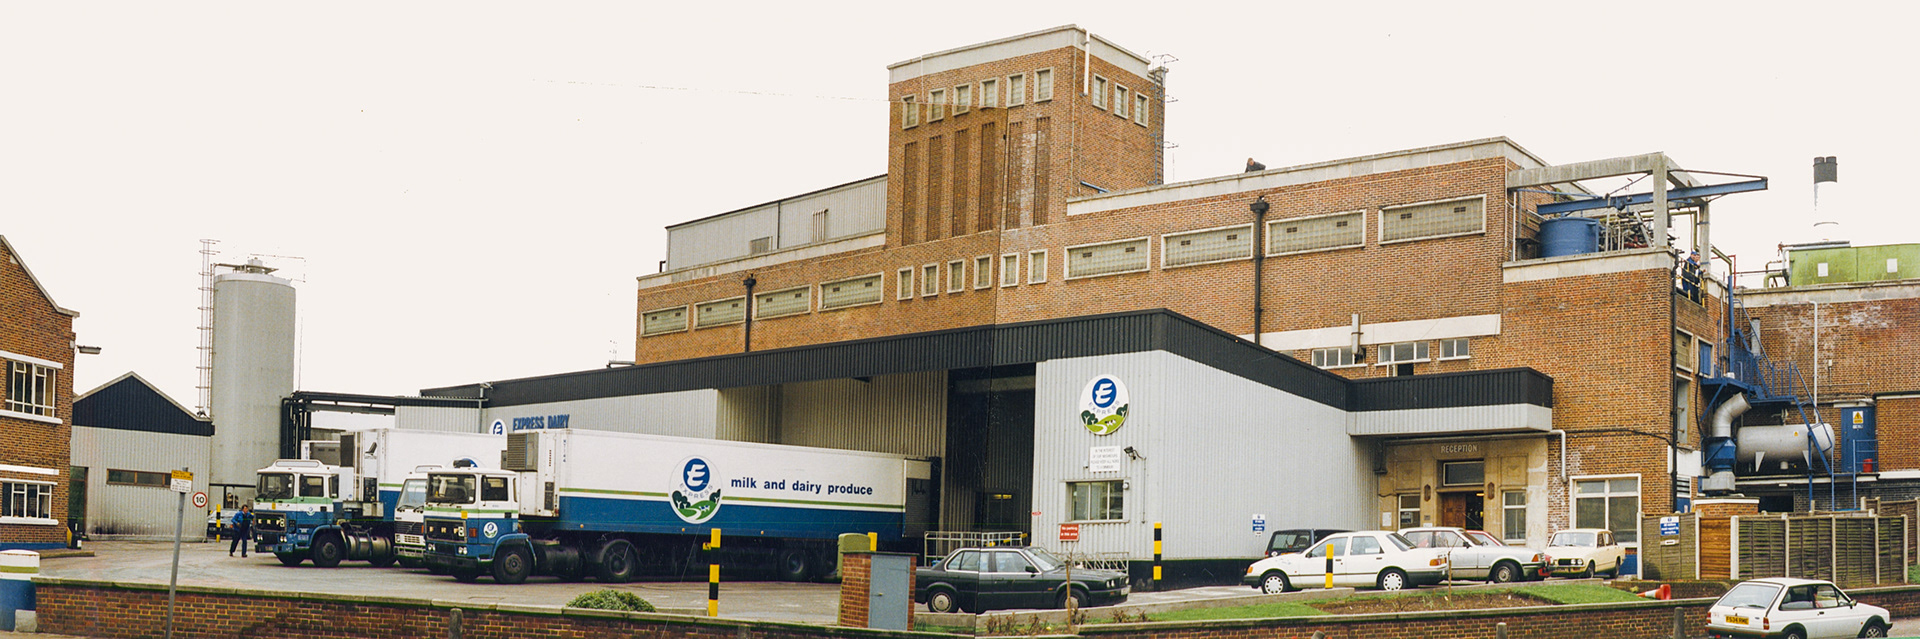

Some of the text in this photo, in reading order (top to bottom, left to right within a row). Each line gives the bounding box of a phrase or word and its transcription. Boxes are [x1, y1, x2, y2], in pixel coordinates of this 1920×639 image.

[513, 414, 569, 431] EXPRESS DAIRY
[1441, 444, 1478, 453] RECEPTION
[731, 476, 873, 495] milk and dairy produce
